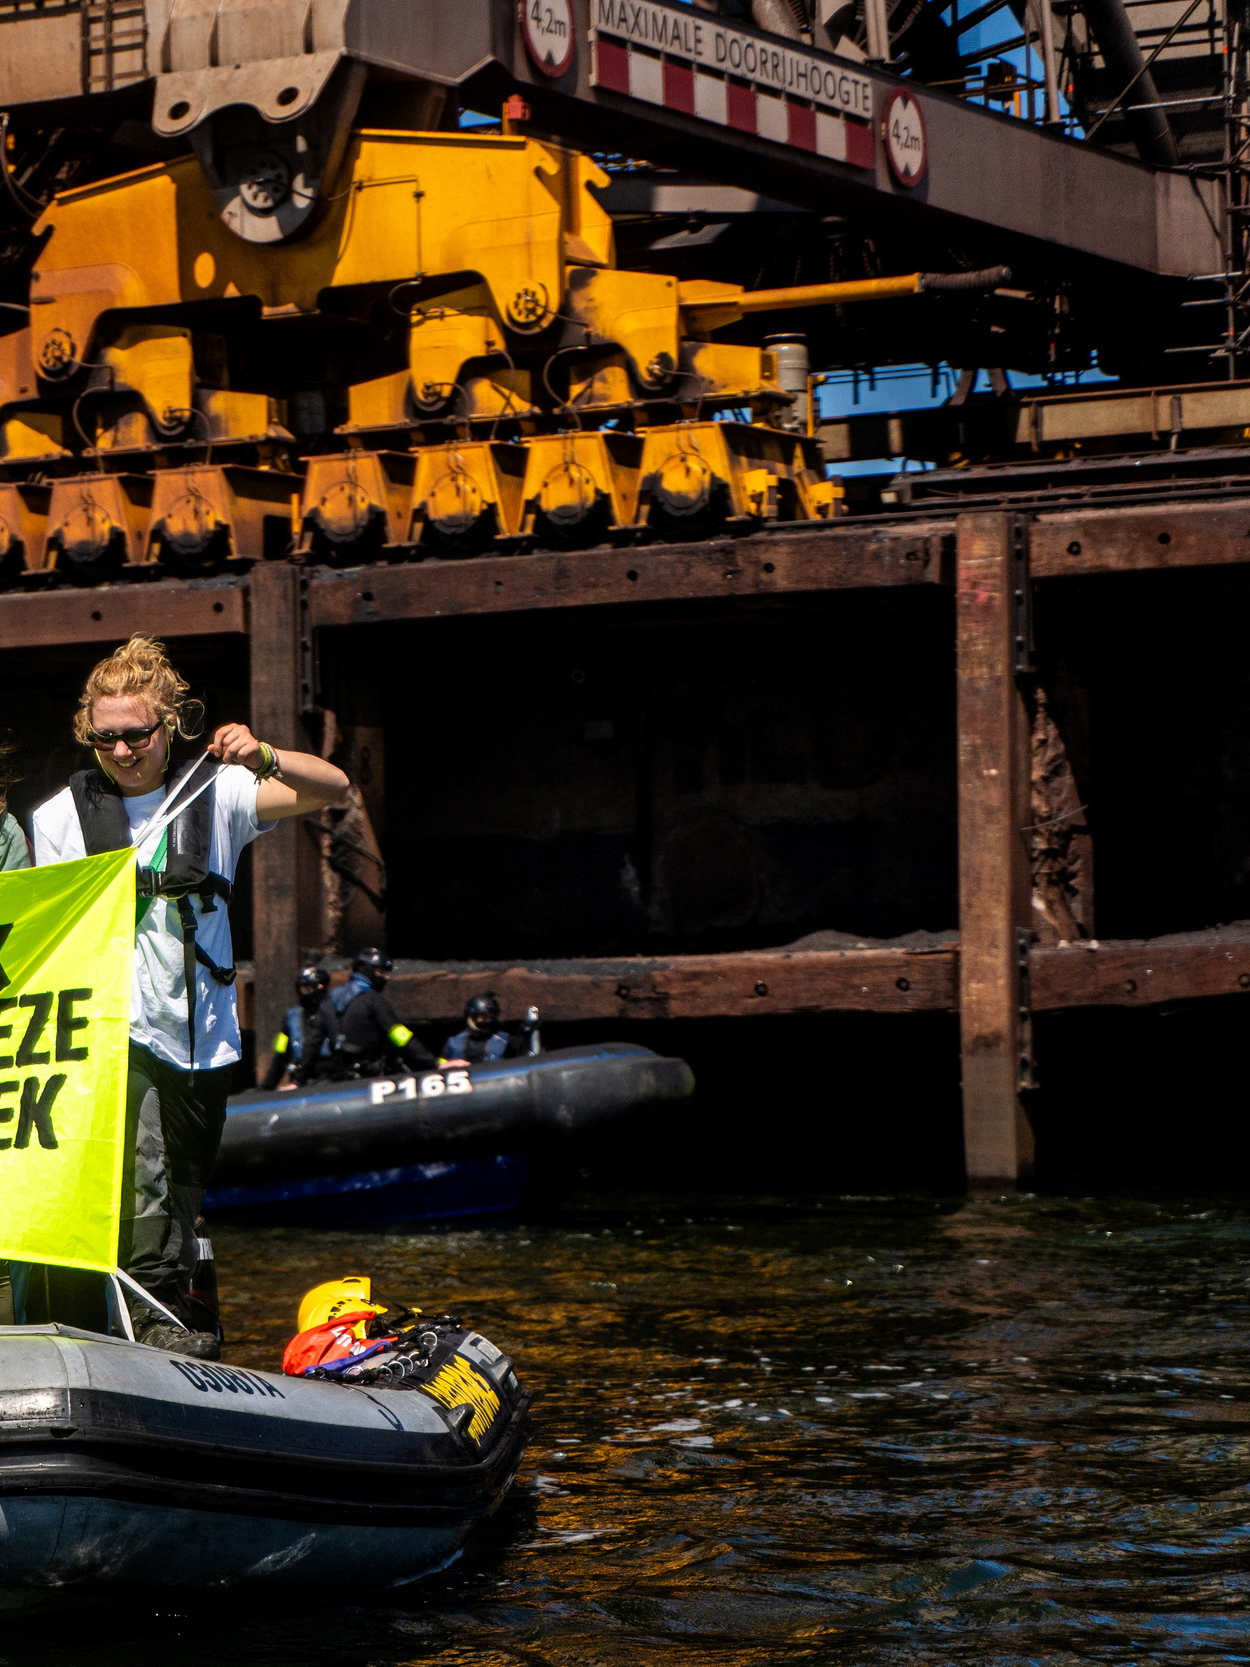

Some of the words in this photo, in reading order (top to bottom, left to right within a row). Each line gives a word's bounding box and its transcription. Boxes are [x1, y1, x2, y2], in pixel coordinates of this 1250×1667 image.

[530, 0, 566, 38] 4,2m
[599, 0, 702, 56] MAXIMALE
[892, 117, 921, 151] 4,2m
[371, 1070, 473, 1104] P165
